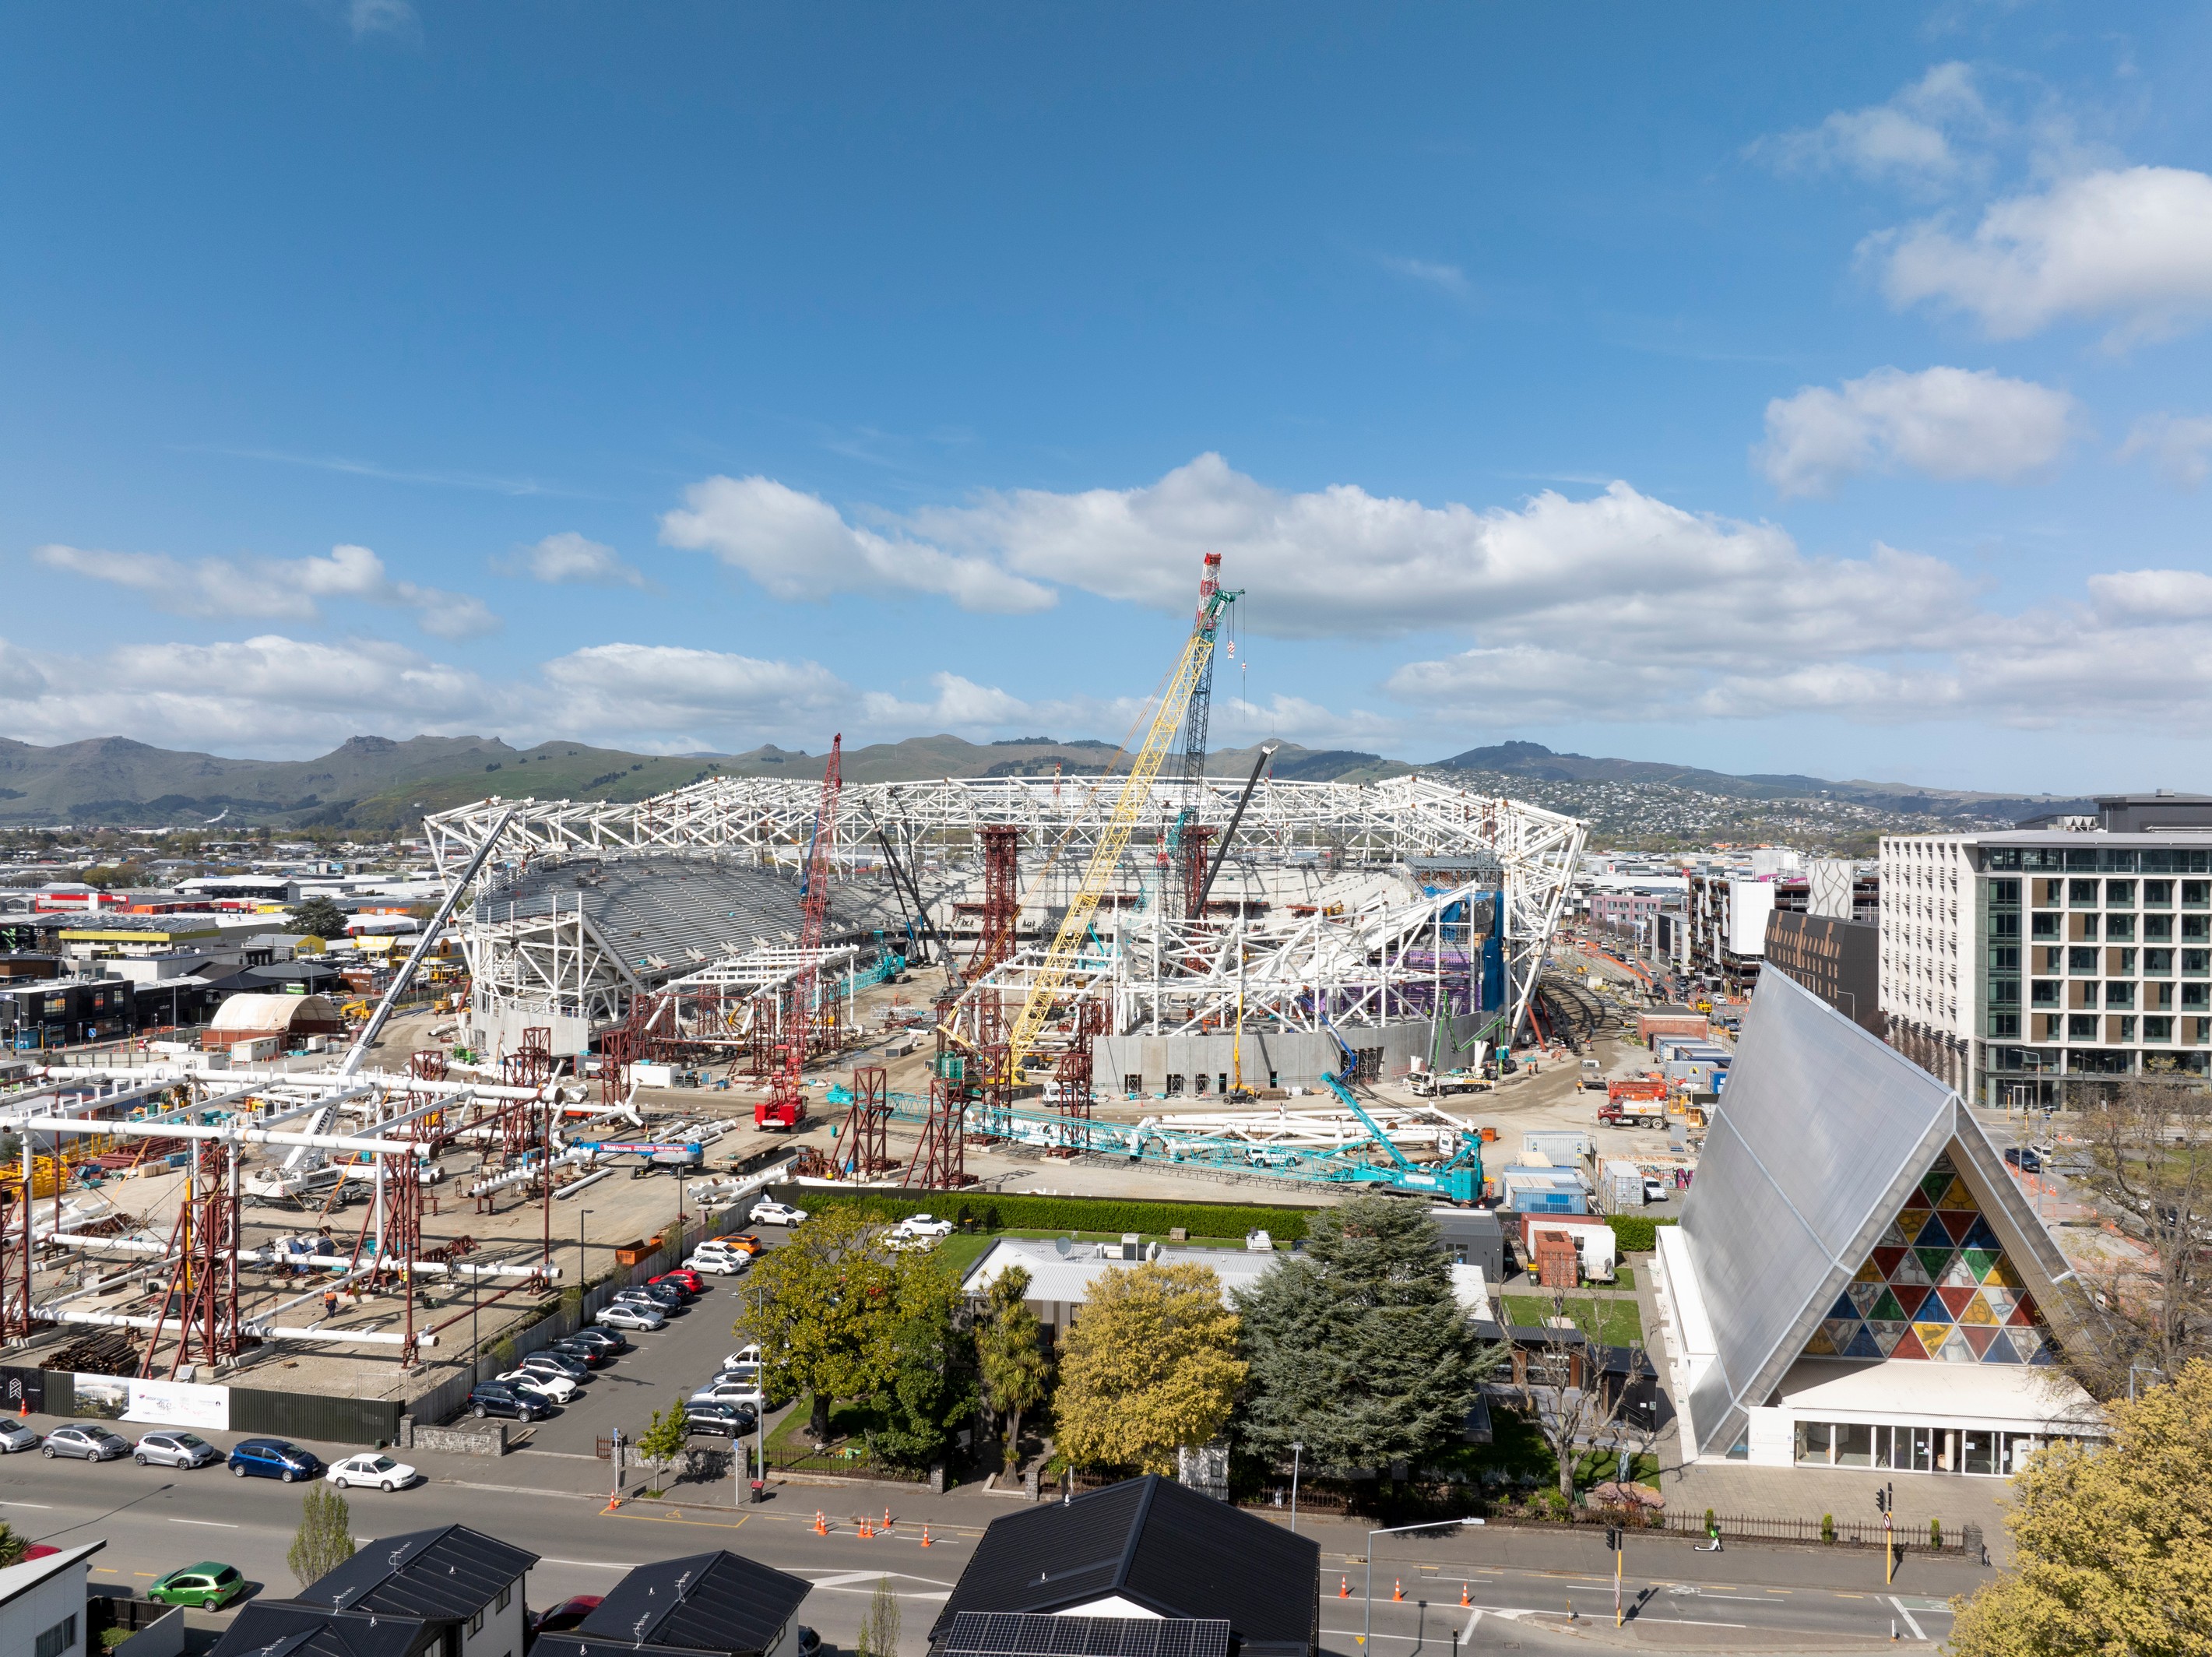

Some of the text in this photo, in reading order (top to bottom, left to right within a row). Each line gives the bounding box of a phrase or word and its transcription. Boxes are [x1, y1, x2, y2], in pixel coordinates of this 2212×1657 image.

[428, 927, 438, 941] SMITH
[403, 967, 413, 982] SMITH
[310, 1172, 336, 1183] SMITH
